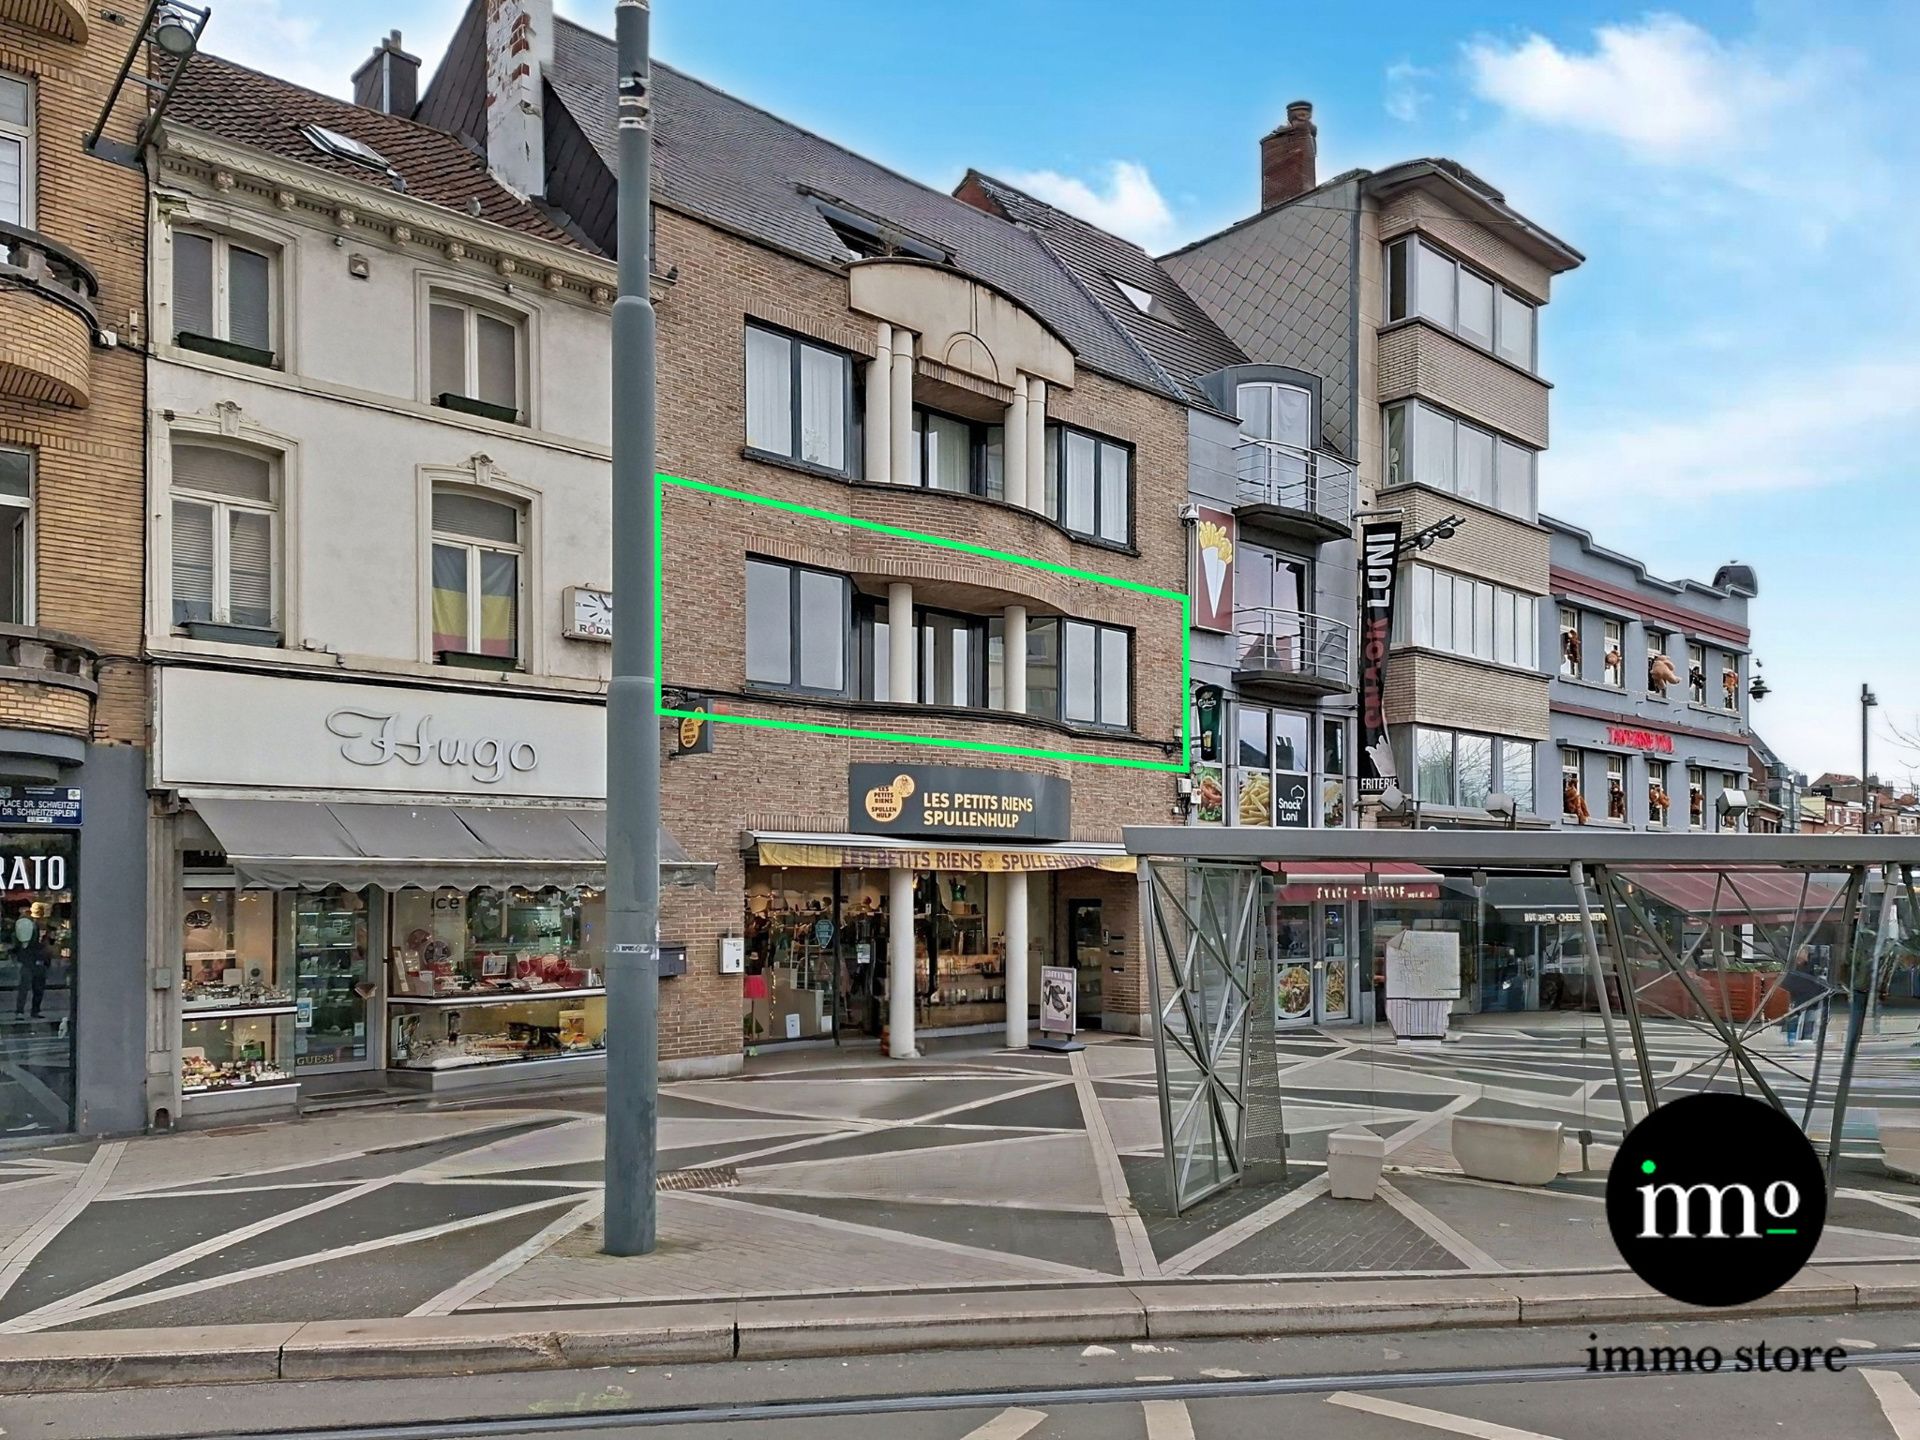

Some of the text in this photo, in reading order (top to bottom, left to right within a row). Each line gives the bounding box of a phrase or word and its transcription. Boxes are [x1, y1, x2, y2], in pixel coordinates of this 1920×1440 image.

[325, 711, 539, 783] Hugo
[38, 801, 80, 810] SCHWEITZER
[923, 792, 1033, 812] LES PETITS RIENS
[1278, 797, 1301, 810] Snack
[16, 808, 77, 818] SCHWEITZERPLEIN
[923, 810, 1019, 829] SPULLENHULP
[1281, 810, 1299, 822] Loni
[936, 852, 983, 869] RIENS
